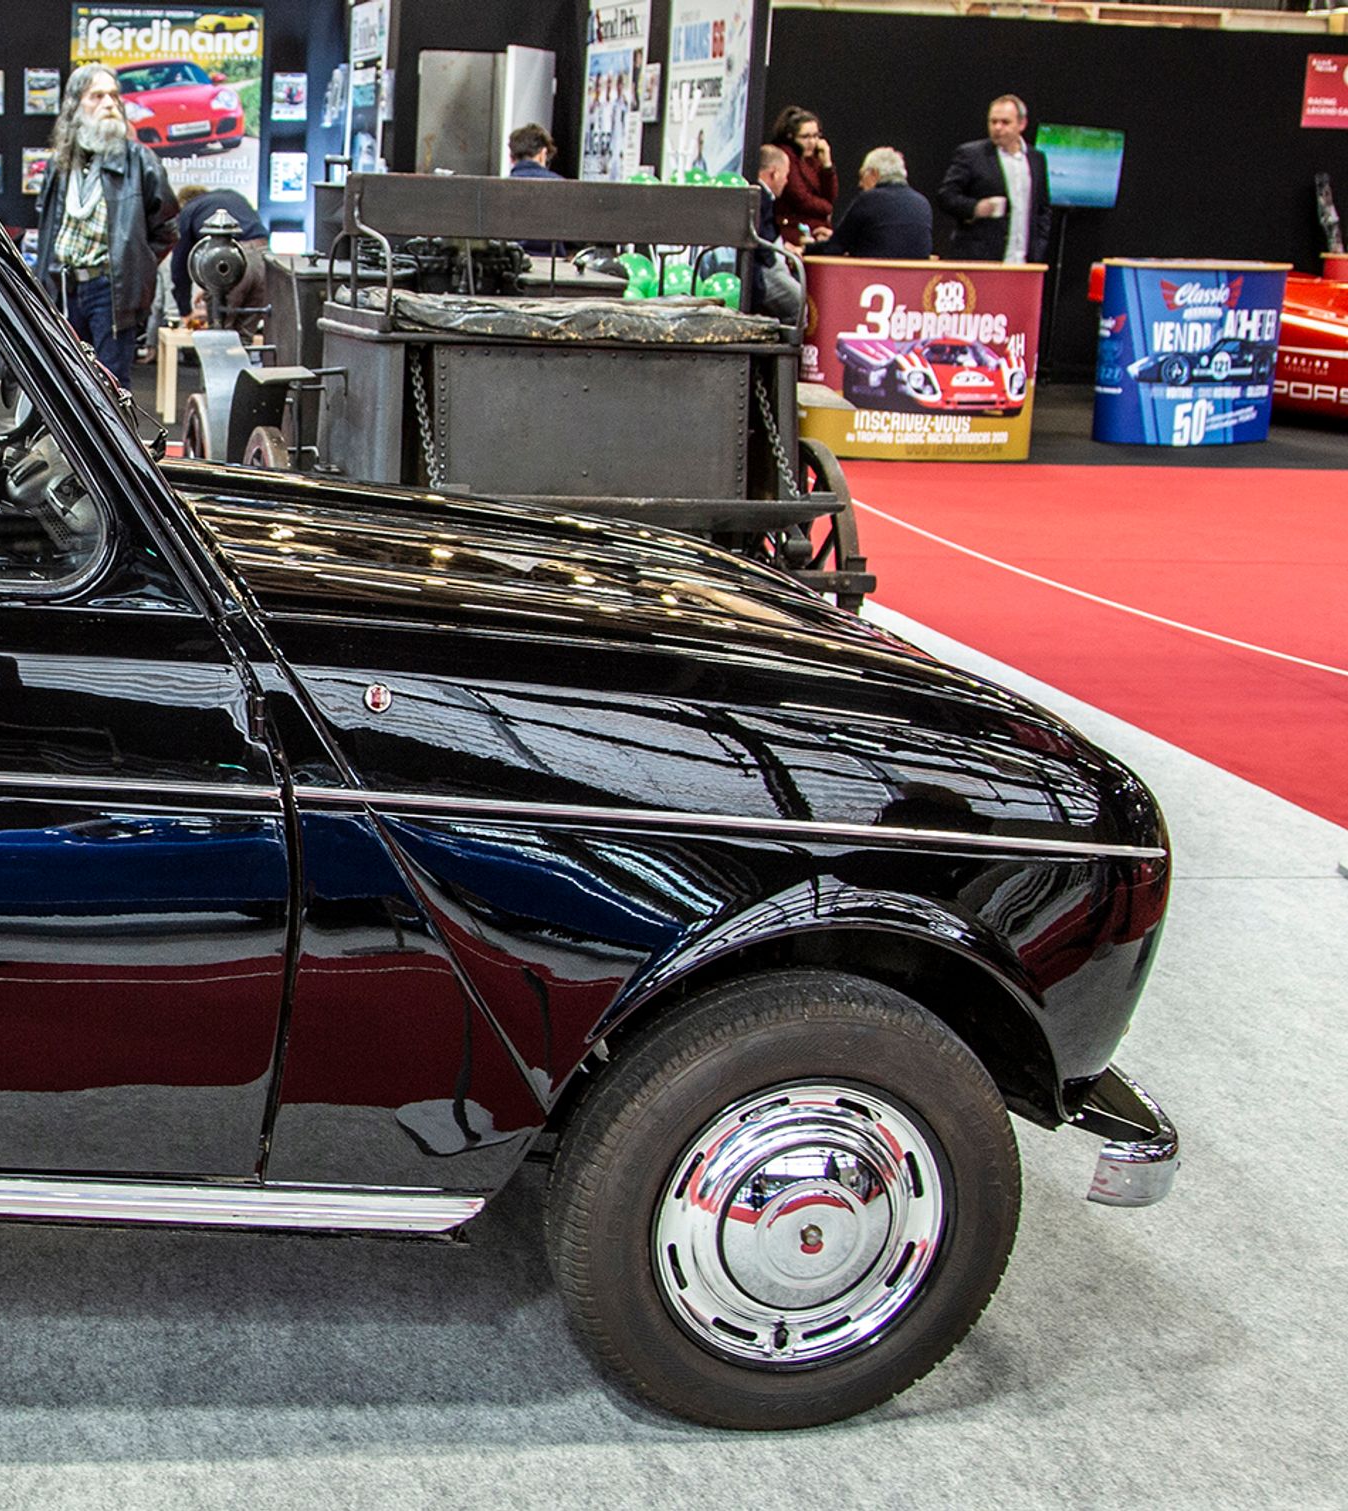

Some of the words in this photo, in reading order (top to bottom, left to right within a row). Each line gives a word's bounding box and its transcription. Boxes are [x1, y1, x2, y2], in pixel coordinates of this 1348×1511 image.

[88, 16, 259, 55] ferdinand
[182, 154, 214, 171] plus
[1174, 282, 1230, 306] Classic
